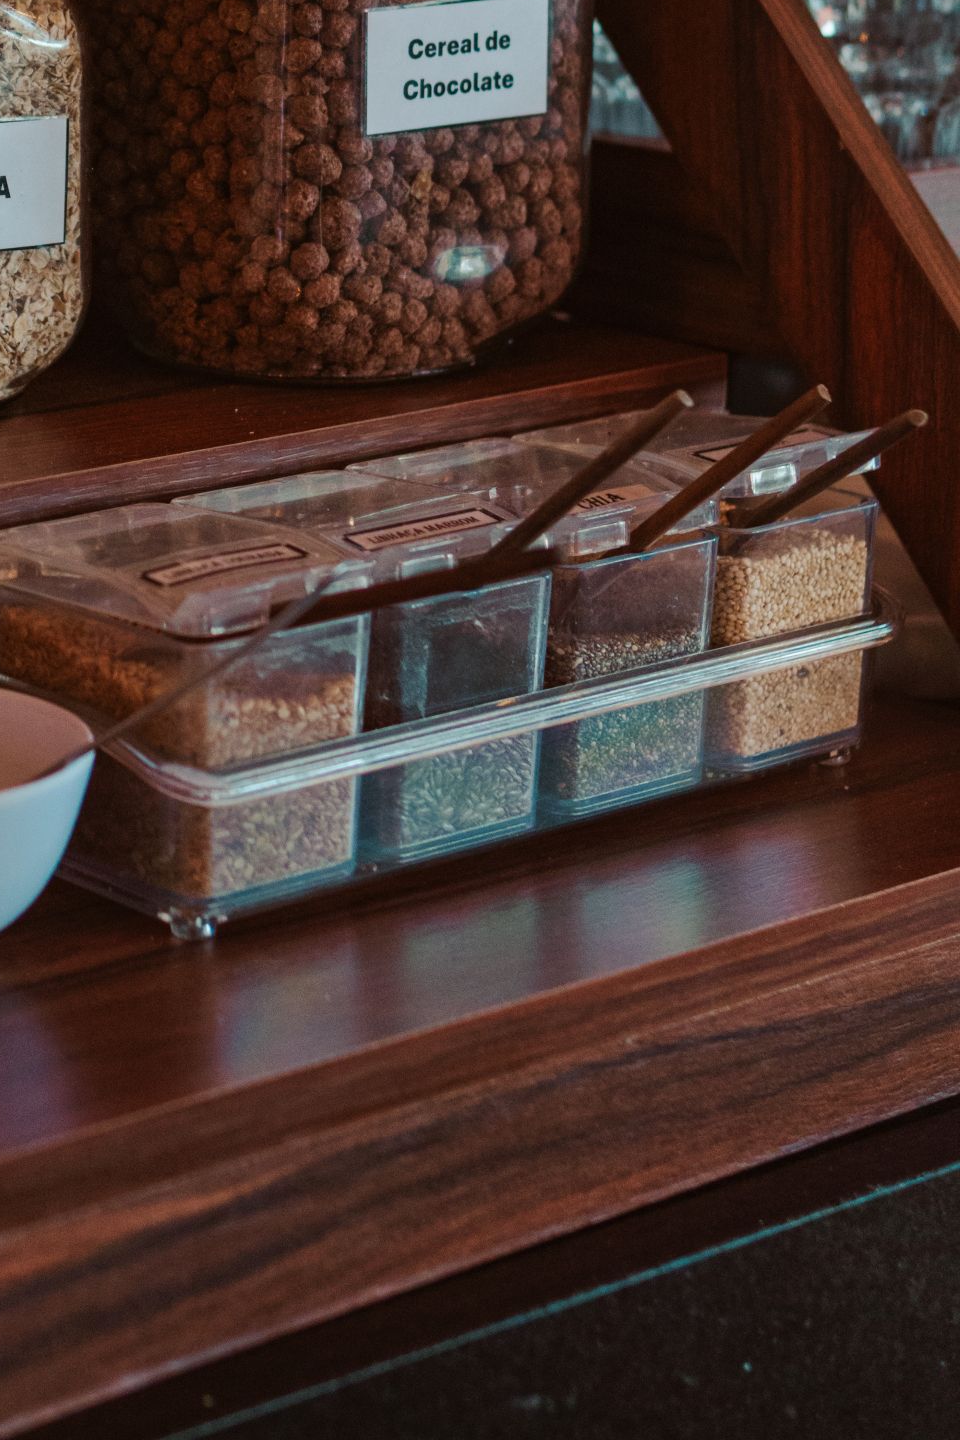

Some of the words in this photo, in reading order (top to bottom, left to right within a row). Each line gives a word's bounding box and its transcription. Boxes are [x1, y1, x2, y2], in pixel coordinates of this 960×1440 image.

[408, 32, 480, 60] Cereal
[485, 30, 511, 51] de
[403, 71, 514, 100] Chocolate
[577, 493, 626, 510] CHIA
